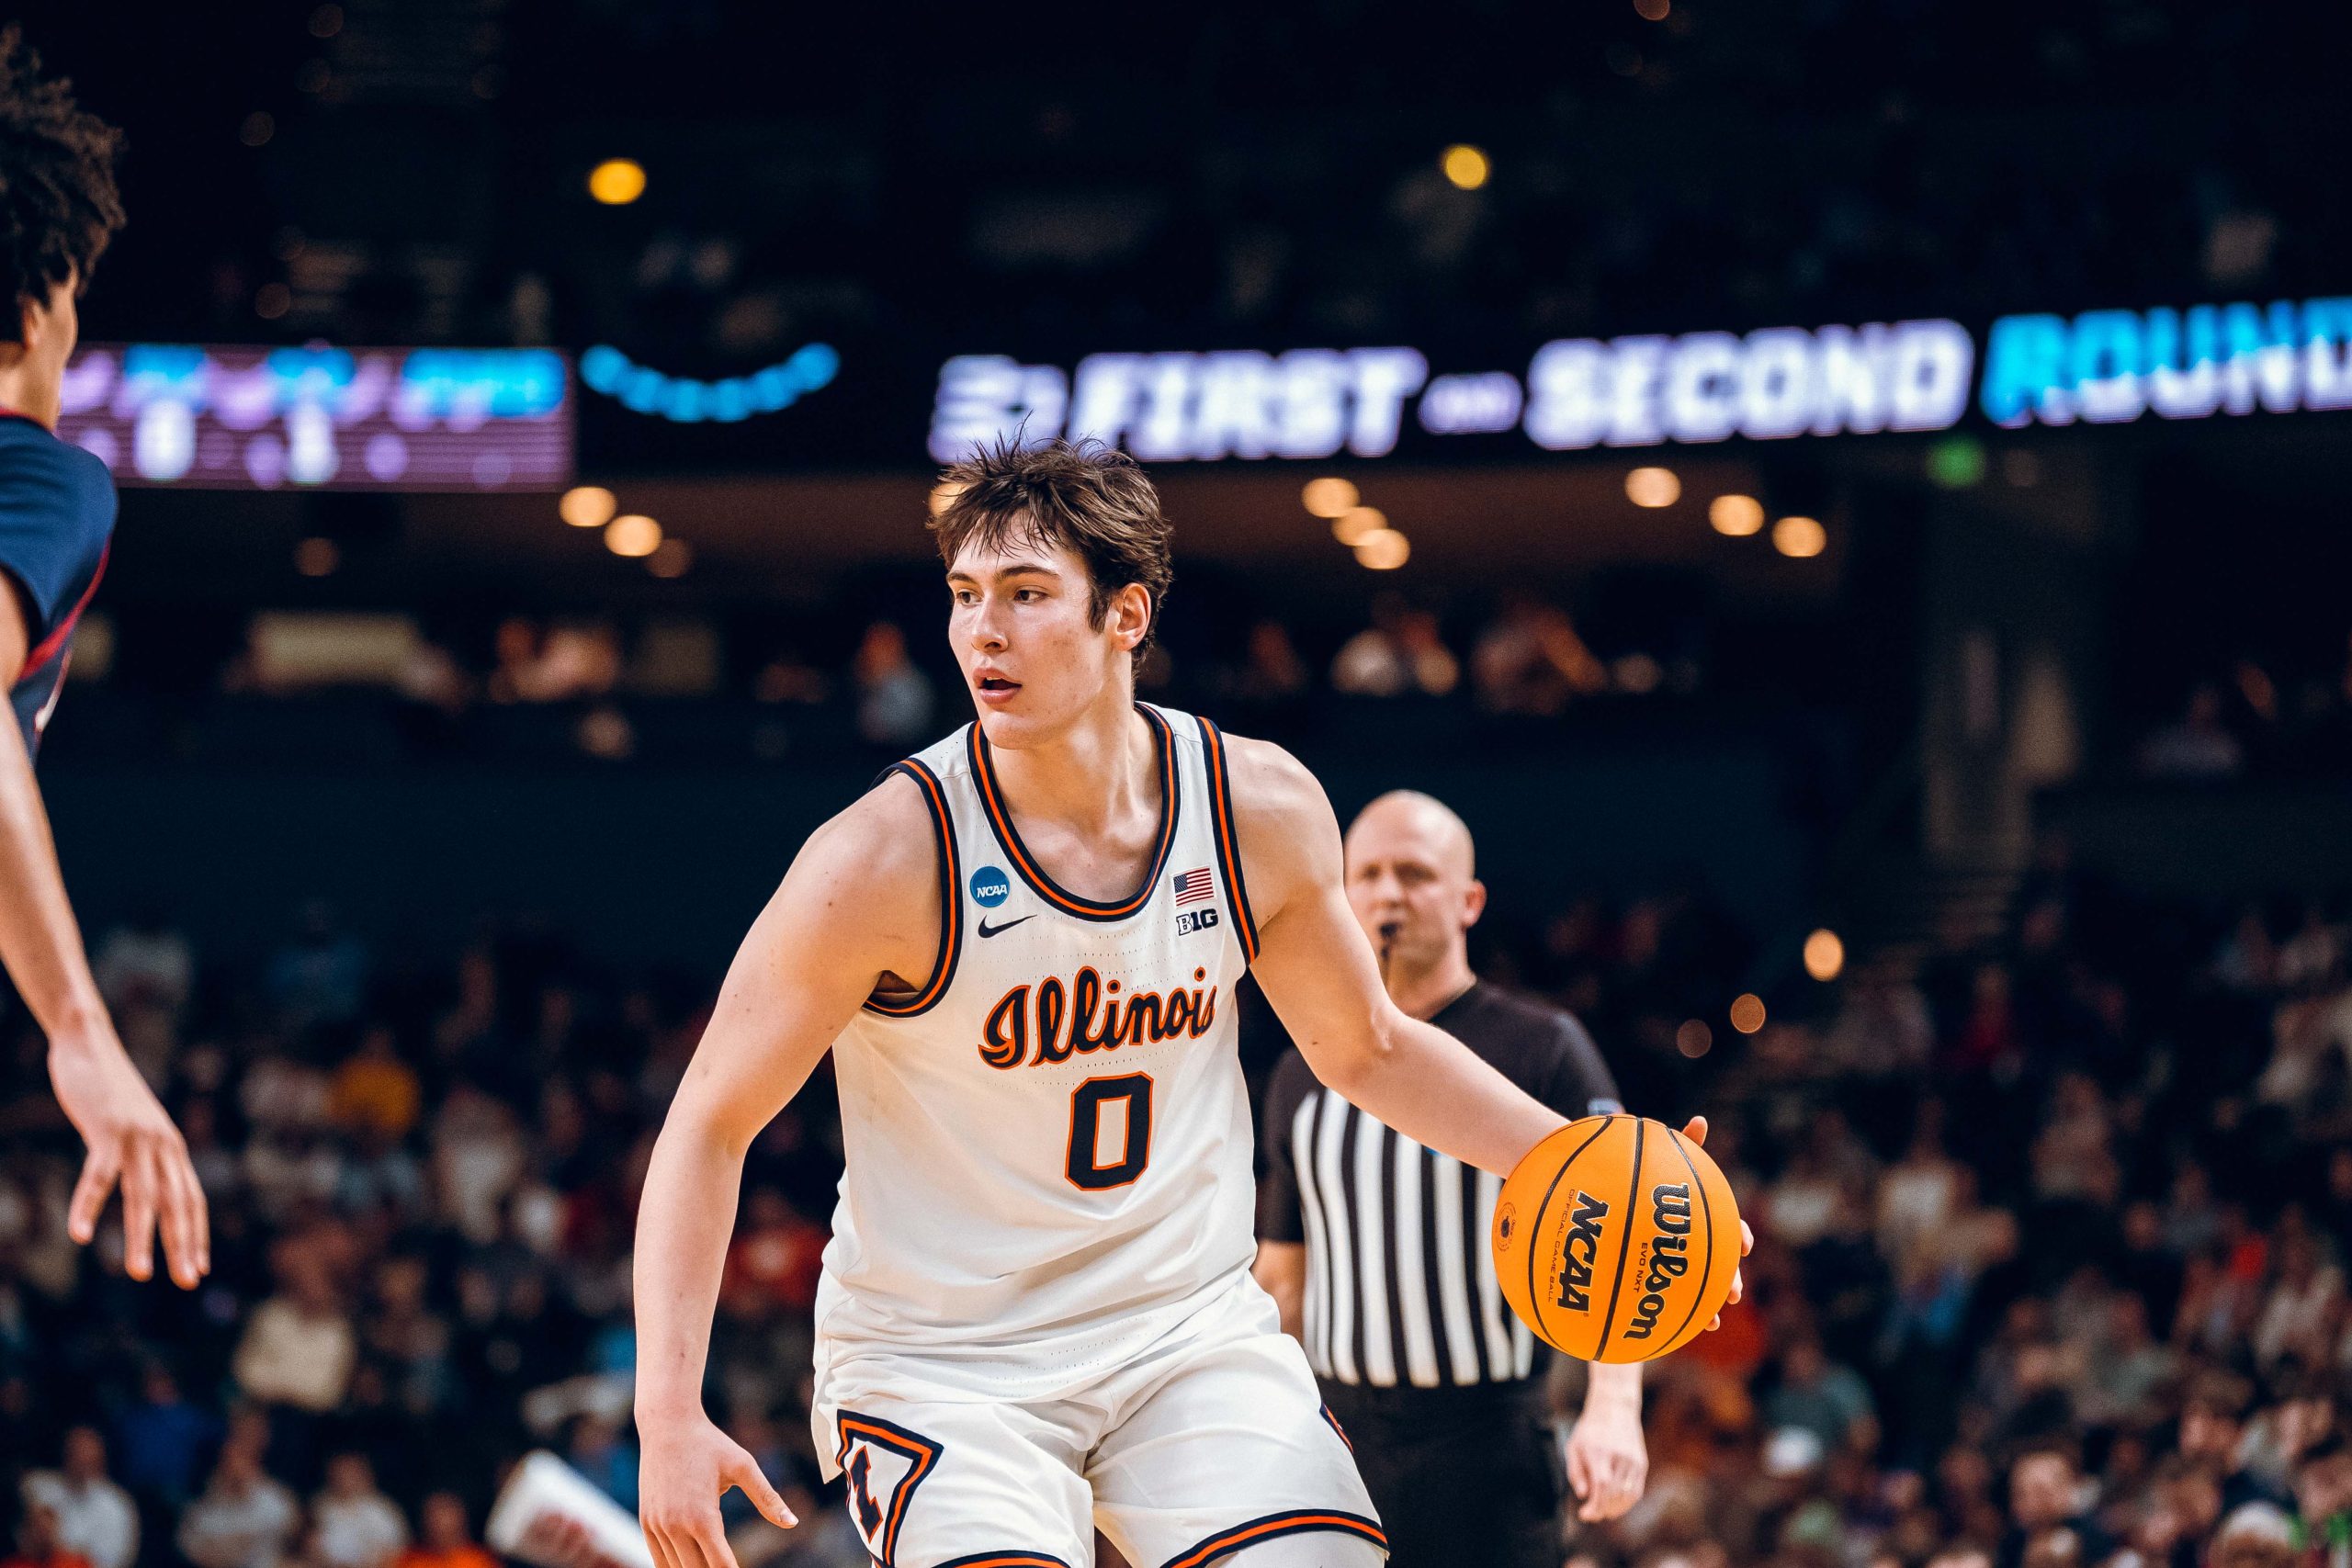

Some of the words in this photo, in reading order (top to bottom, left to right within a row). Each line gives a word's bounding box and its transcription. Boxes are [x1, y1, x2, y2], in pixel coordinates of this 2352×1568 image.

[1067, 346, 1429, 460] FIRST
[1524, 320, 1973, 449] SECOND
[977, 884, 1008, 898] NCAA
[978, 966, 1217, 1070] Illinois
[1065, 1071, 1154, 1191] 0
[1557, 1189, 1575, 1235] OFFICIAL
[1551, 1240, 1561, 1272] GAME
[1557, 1190, 1610, 1313] NCAA
[1623, 1182, 1691, 1340] Wilson
[1634, 1269, 1644, 1293] NXT
[1639, 1242, 1648, 1267] EVO
